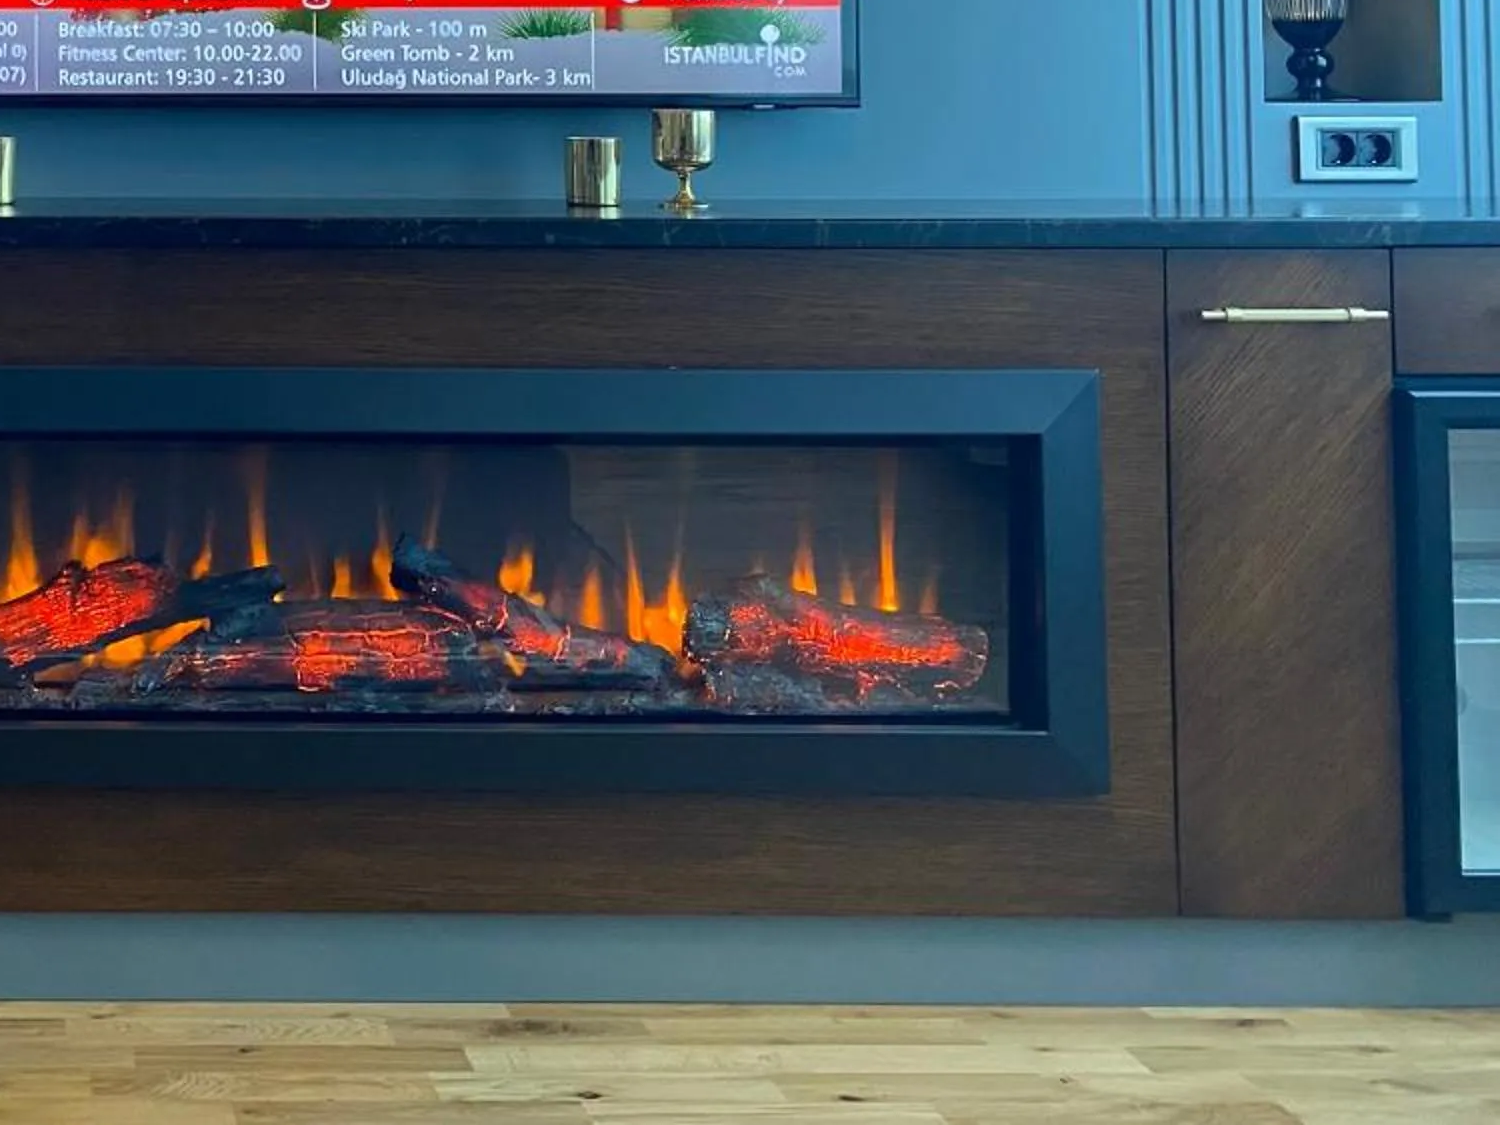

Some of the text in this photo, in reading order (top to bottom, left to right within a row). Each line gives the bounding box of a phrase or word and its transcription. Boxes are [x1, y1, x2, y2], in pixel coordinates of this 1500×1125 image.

[58, 21, 145, 38] Breakfast:
[150, 21, 200, 38] 07:30
[225, 21, 275, 38] 10:00
[341, 21, 367, 38] Ski
[372, 21, 411, 38] Park
[429, 21, 463, 38] 100
[469, 25, 487, 38] m
[58, 45, 118, 62] Fitness
[123, 45, 187, 62] Center:
[341, 45, 395, 62] Green
[400, 44, 450, 62] Tomb
[468, 45, 480, 62] 2
[486, 44, 515, 62] km
[58, 69, 159, 86] Restaurant:
[166, 69, 216, 86] 19:30
[233, 68, 286, 86] 21:30
[341, 68, 591, 89] Uludağ National Park- 3 km
